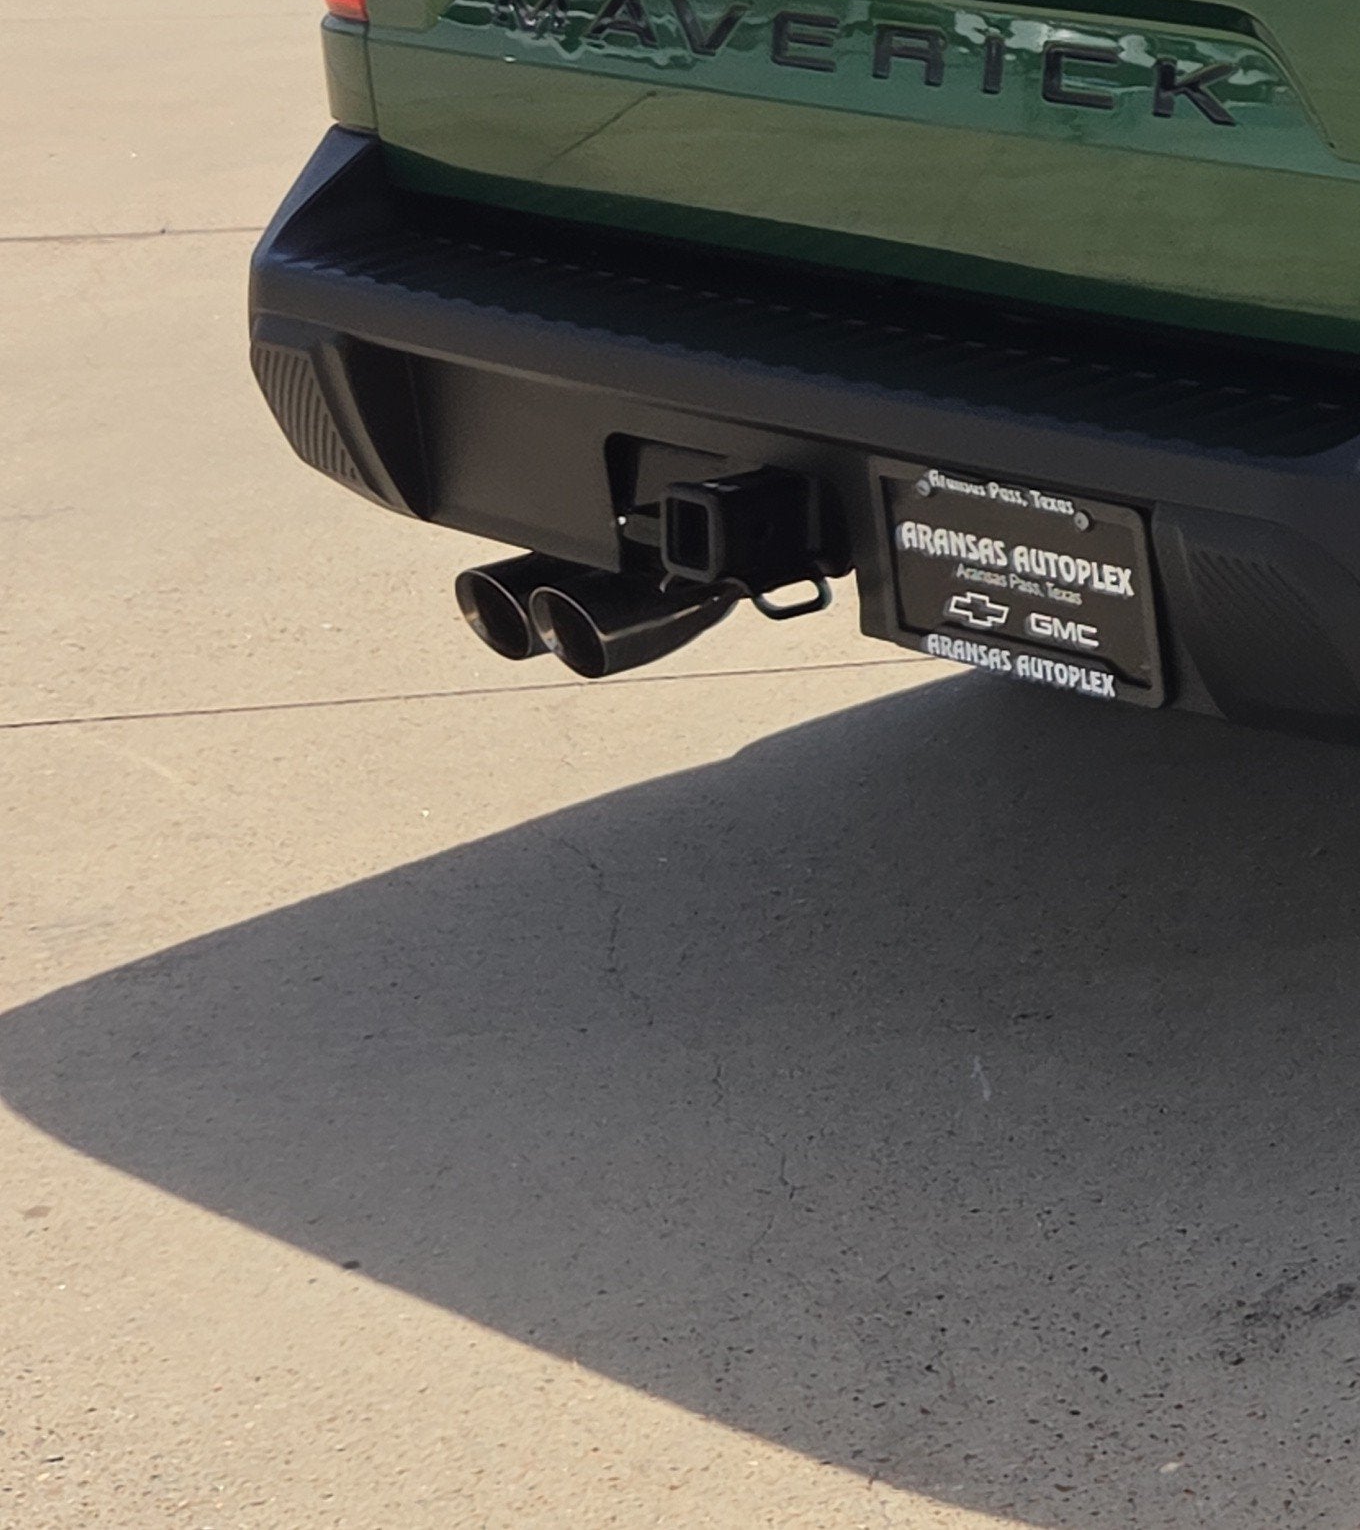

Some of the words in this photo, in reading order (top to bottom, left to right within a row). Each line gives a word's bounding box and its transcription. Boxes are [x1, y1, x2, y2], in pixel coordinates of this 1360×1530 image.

[1029, 489, 1075, 515] Texas
[901, 521, 1008, 567] ARANSAS
[1012, 545, 1135, 597] AUTOPLEX
[1029, 611, 1100, 648] GMC
[926, 633, 1013, 672] ARANSAS
[1016, 654, 1116, 698] AUTOPLEX
